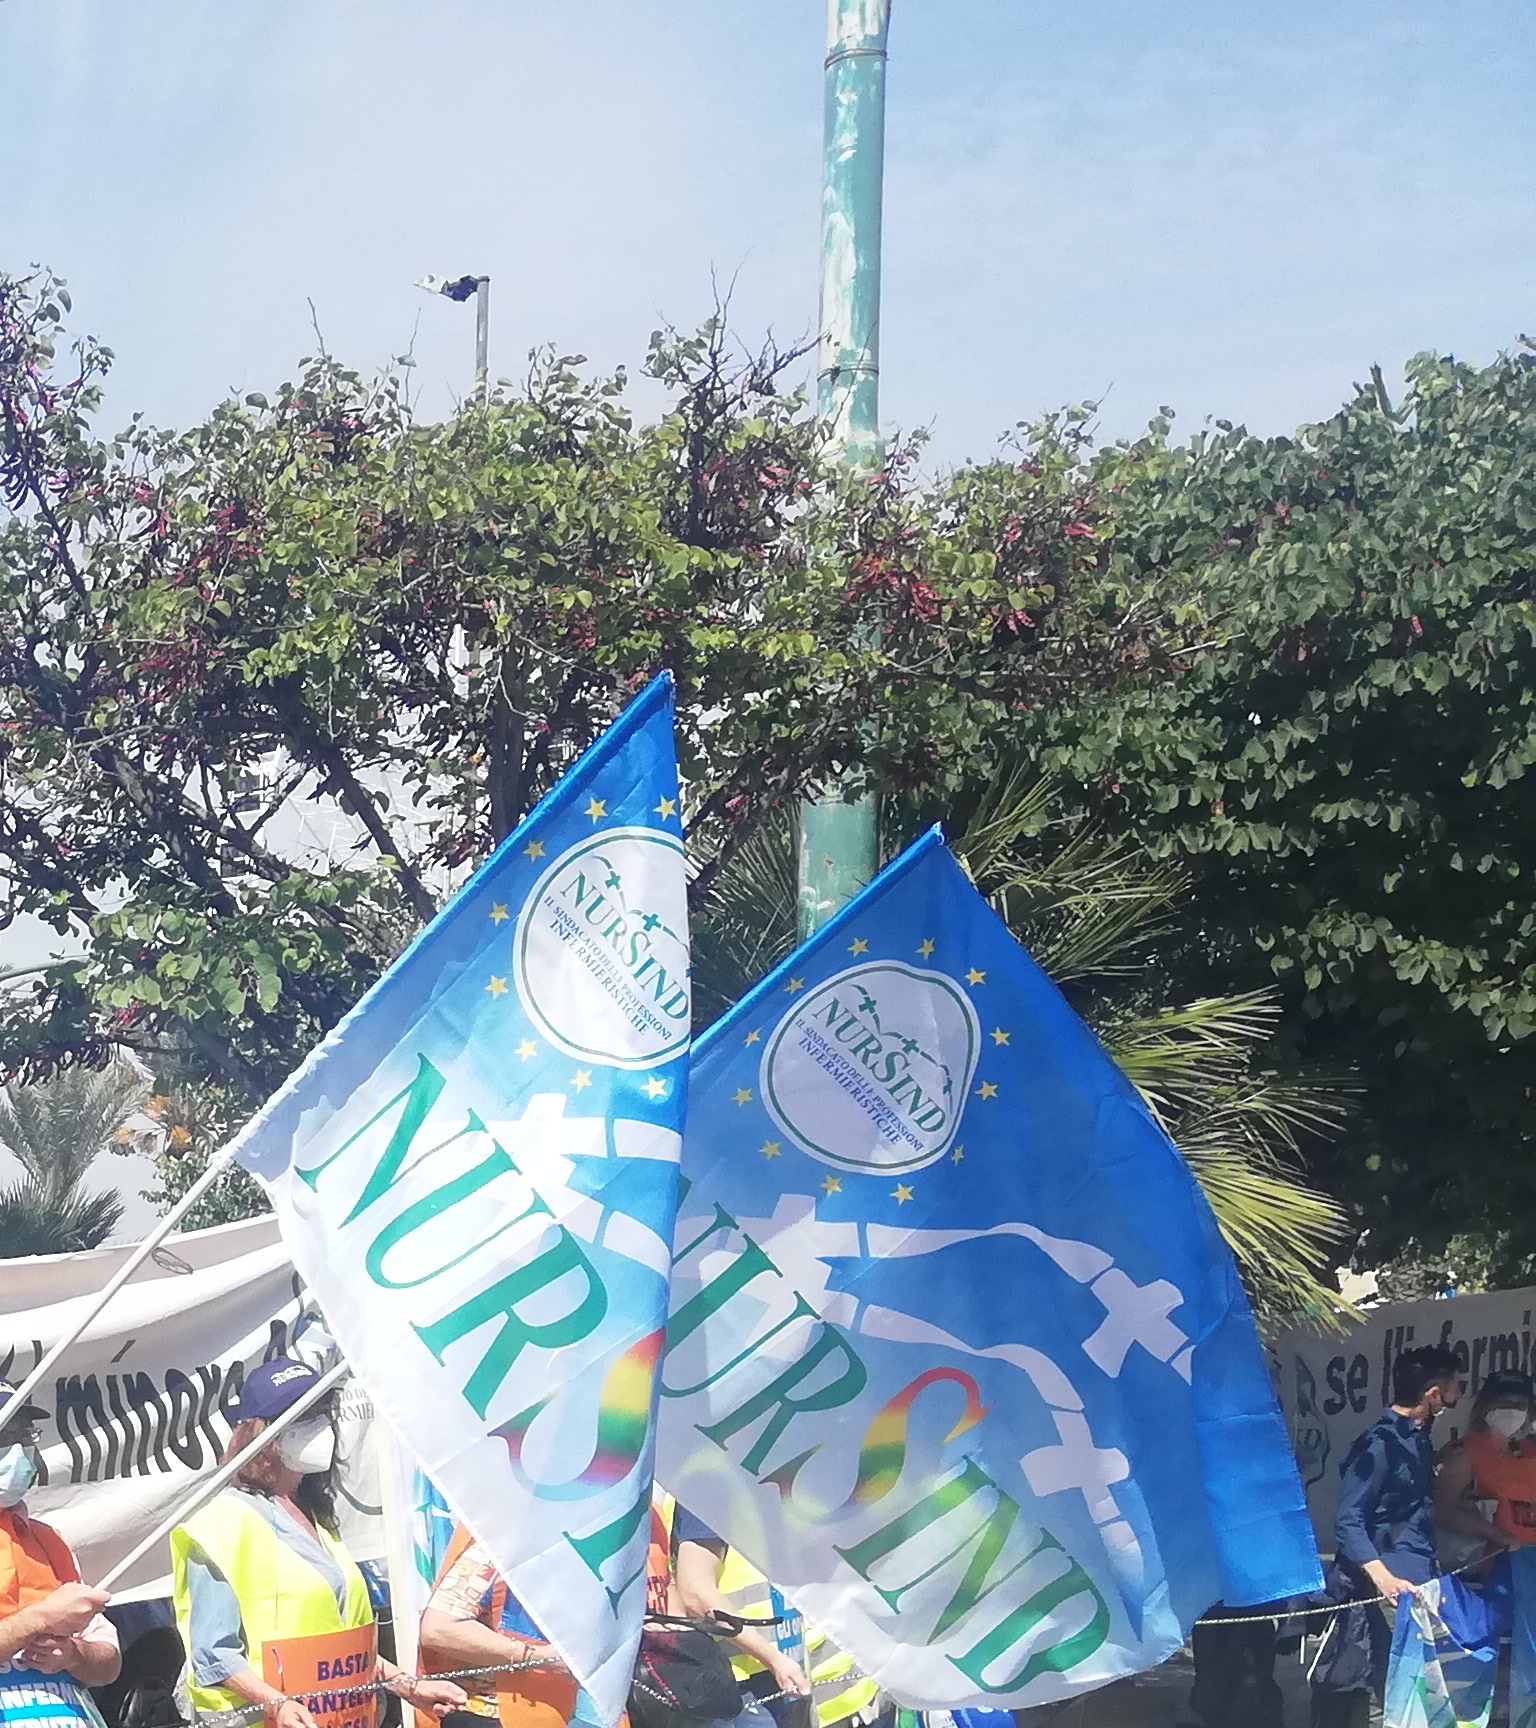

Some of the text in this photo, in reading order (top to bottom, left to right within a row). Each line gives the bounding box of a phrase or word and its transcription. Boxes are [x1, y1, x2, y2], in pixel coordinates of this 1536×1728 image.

[550, 919, 650, 1036] INFERMIERISTICHE
[799, 1037, 902, 1145] INFERMIERISTICHE
[804, 1026, 850, 1073] SINDACATO
[871, 1094, 924, 1152] PROFESSIONI
[1323, 1353, 1369, 1416] se
[318, 1651, 368, 1681] BASTA
